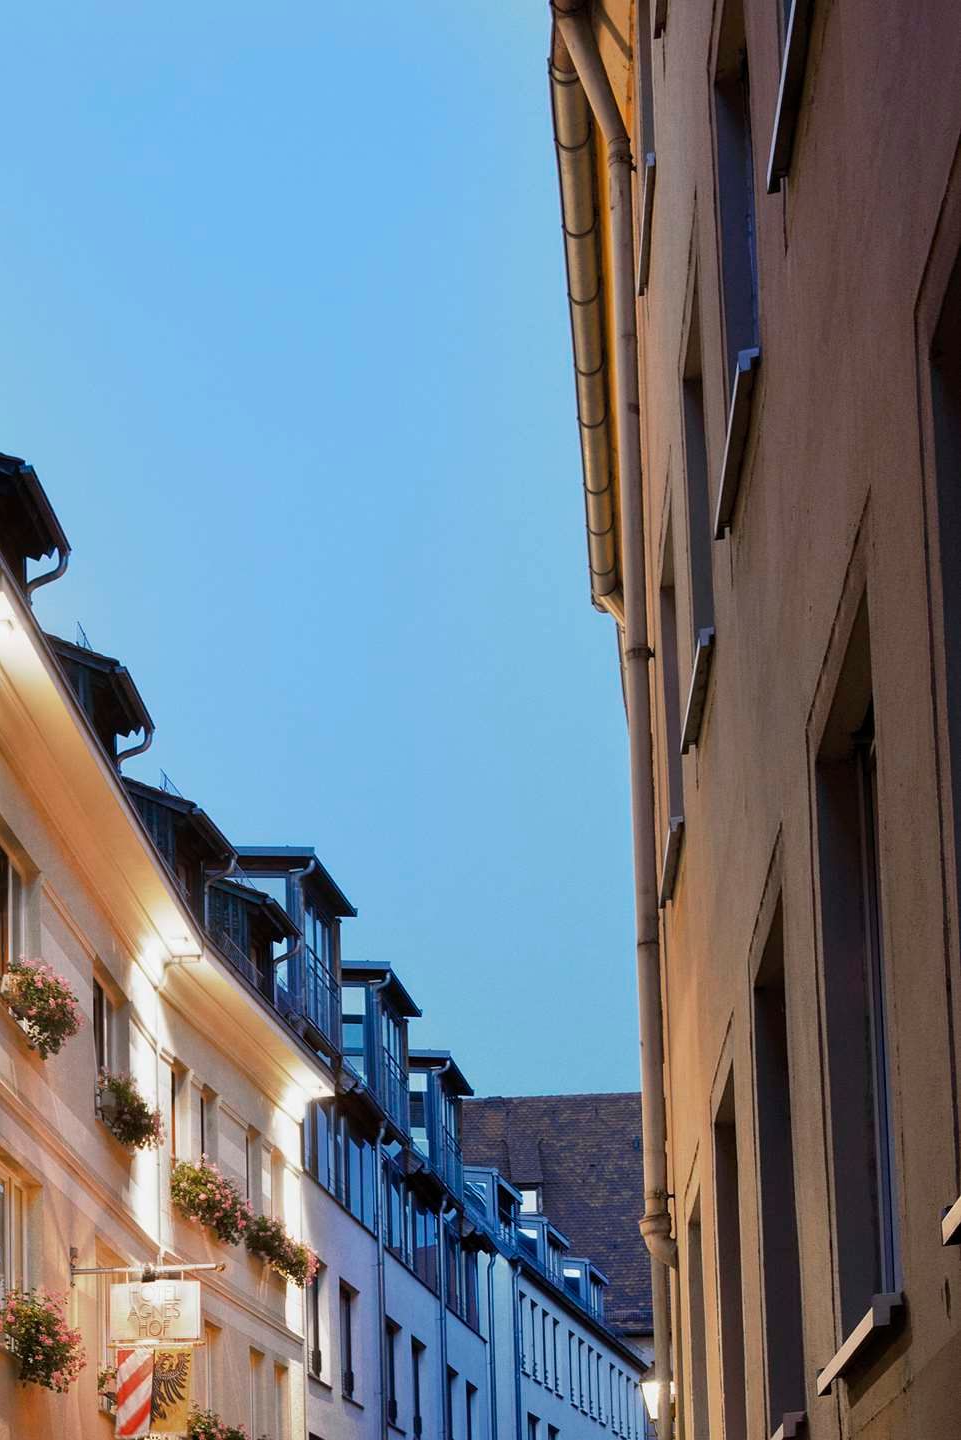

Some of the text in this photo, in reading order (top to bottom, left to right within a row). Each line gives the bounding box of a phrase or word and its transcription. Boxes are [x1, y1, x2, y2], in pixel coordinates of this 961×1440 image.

[129, 1285, 181, 1302] HOTEL
[127, 1303, 181, 1320] AGNES
[138, 1320, 171, 1336] HOF
